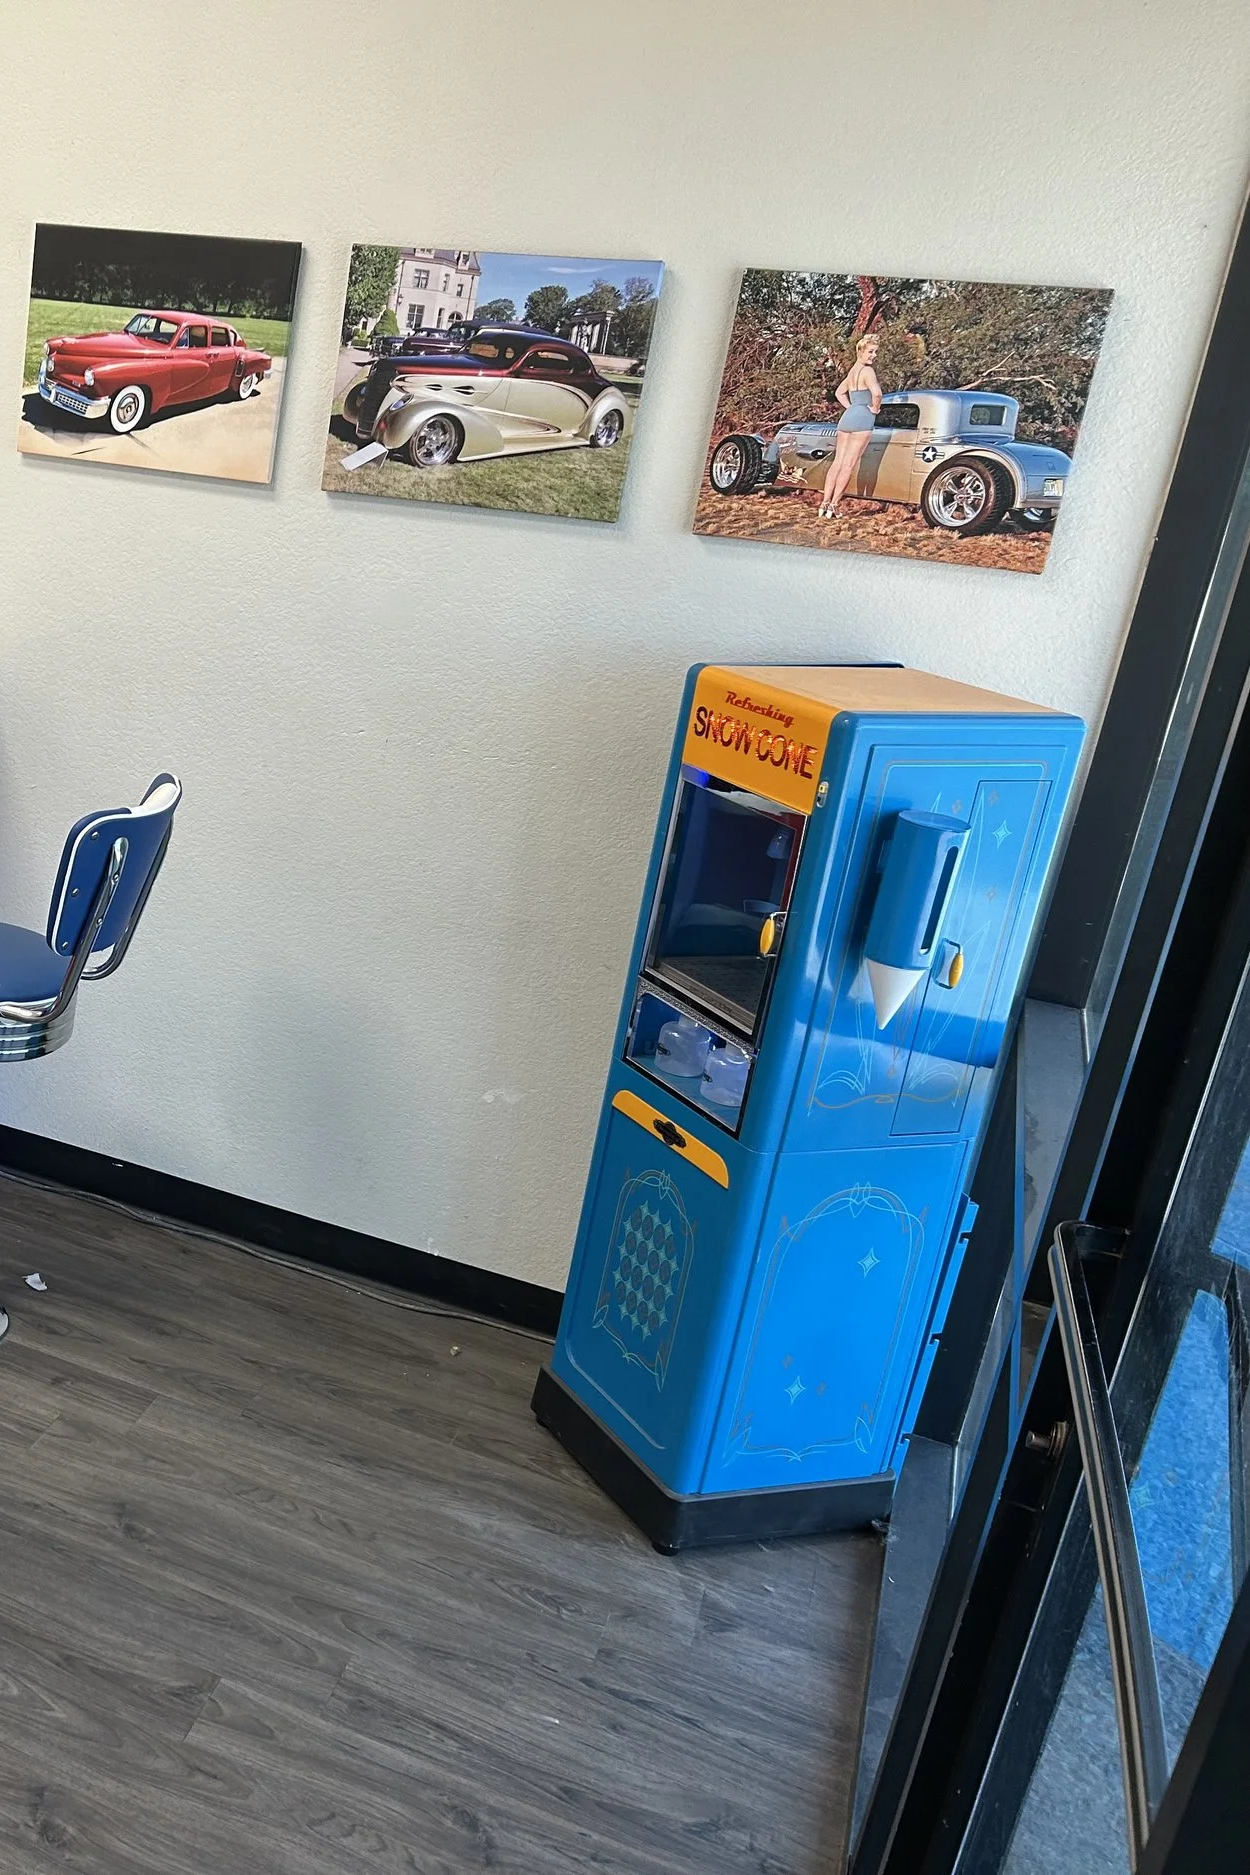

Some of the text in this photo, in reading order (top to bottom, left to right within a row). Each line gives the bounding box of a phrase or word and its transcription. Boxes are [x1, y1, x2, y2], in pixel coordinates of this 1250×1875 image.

[724, 691, 795, 729] Refreshing
[693, 706, 818, 780] SNOW CONE
